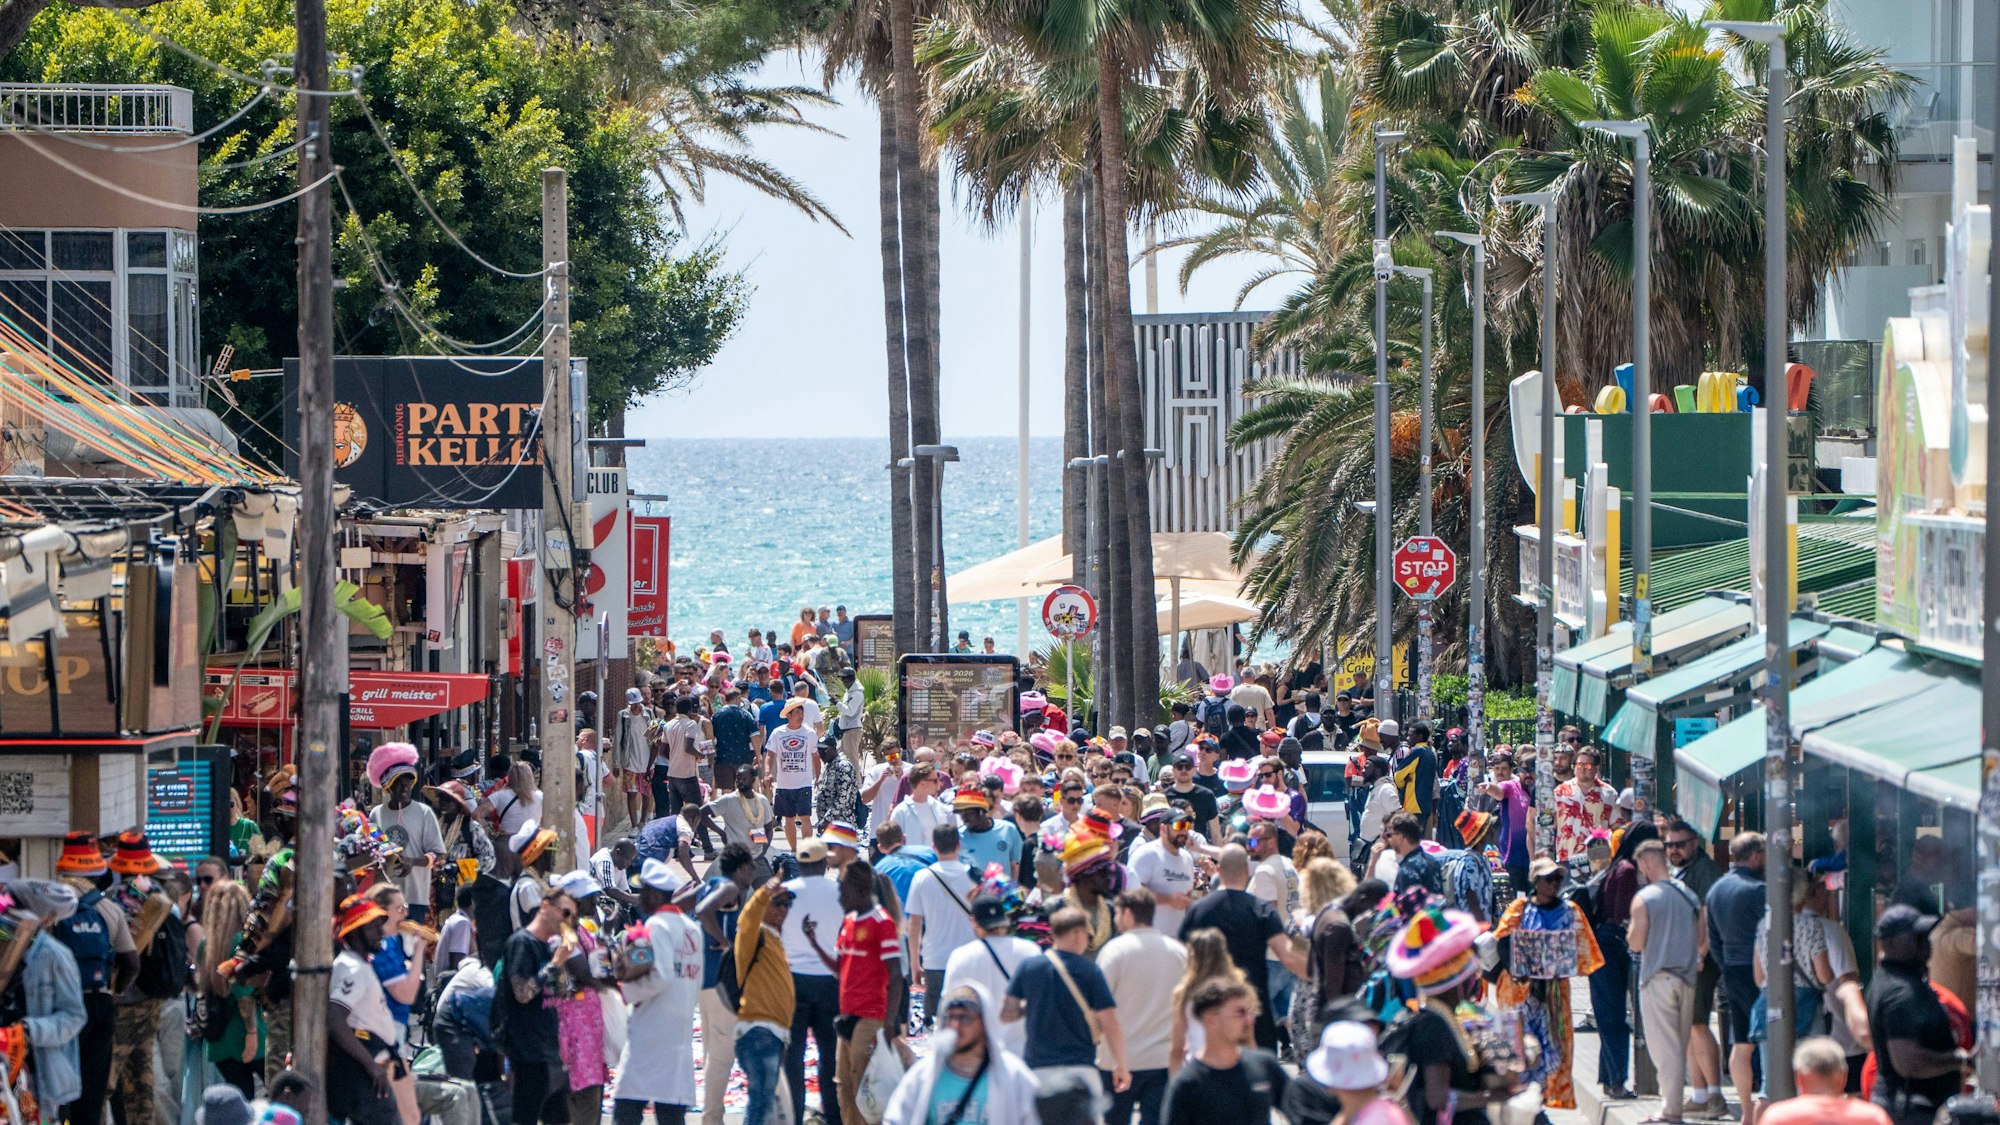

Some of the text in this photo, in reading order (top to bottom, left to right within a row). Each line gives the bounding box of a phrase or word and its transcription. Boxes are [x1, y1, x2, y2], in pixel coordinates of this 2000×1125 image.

[395, 403, 404, 465] BIERKÖNIG
[587, 472, 619, 494] CLUB
[1400, 561, 1449, 576] STOP
[361, 688, 389, 701] grill
[350, 707, 374, 715] GRILL
